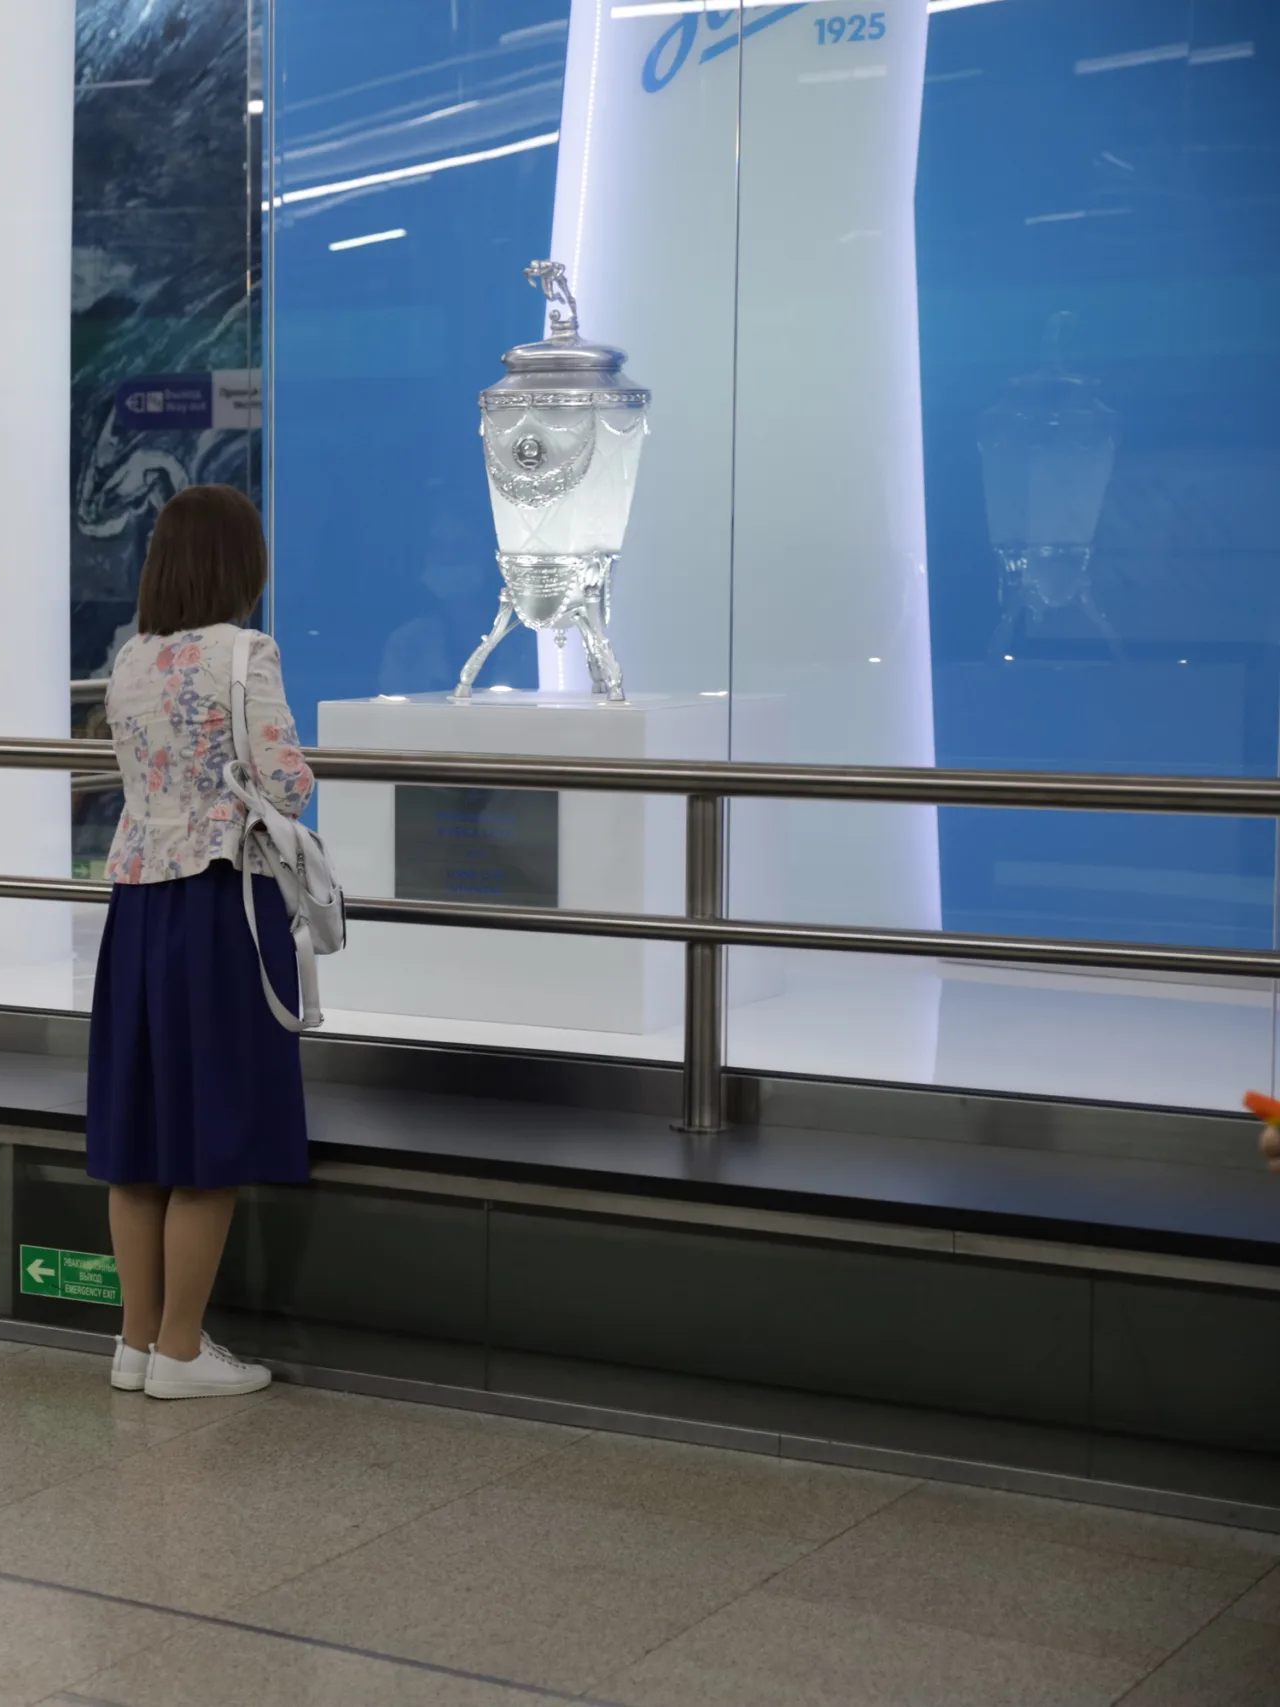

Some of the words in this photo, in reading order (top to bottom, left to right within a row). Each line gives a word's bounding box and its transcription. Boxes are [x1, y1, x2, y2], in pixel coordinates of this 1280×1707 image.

[814, 12, 886, 45] 1925
[65, 1284, 102, 1297] EMERGENCY
[103, 1289, 116, 1299] EXIT
